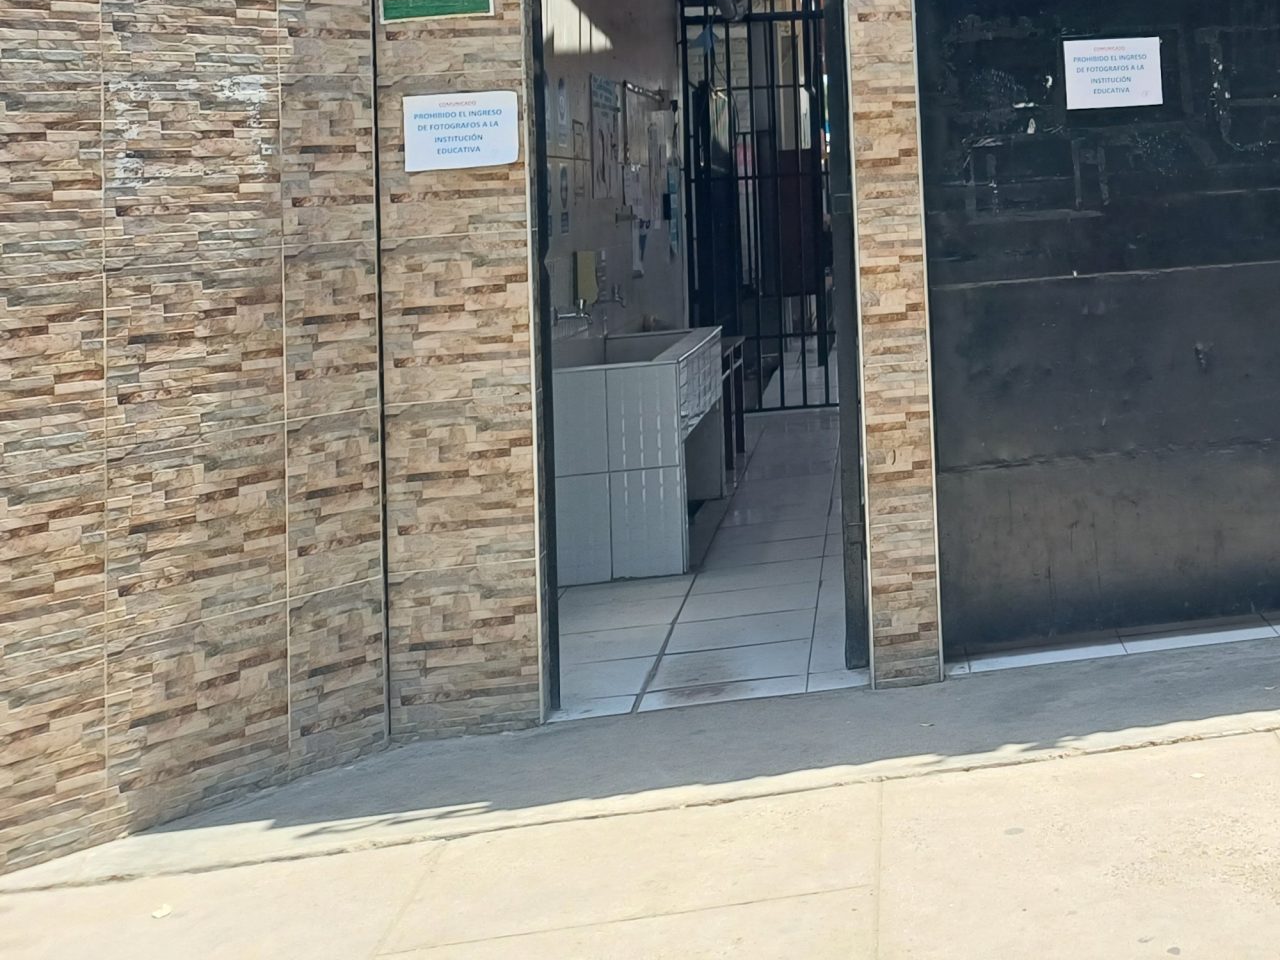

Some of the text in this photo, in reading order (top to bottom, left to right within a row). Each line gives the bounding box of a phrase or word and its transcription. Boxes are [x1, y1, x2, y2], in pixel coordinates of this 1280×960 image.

[1073, 55, 1109, 63] PROHIBIDO
[1090, 76, 1131, 84] INSTITUCIÓN
[1093, 87, 1130, 95] EDUCATIVA
[414, 109, 503, 120] PROHIBIDO EL INGRESO
[429, 121, 481, 131] FOTOGRAFOS
[434, 134, 483, 143] INSTITUCIÓN
[437, 145, 481, 155] EDUCATIVA
